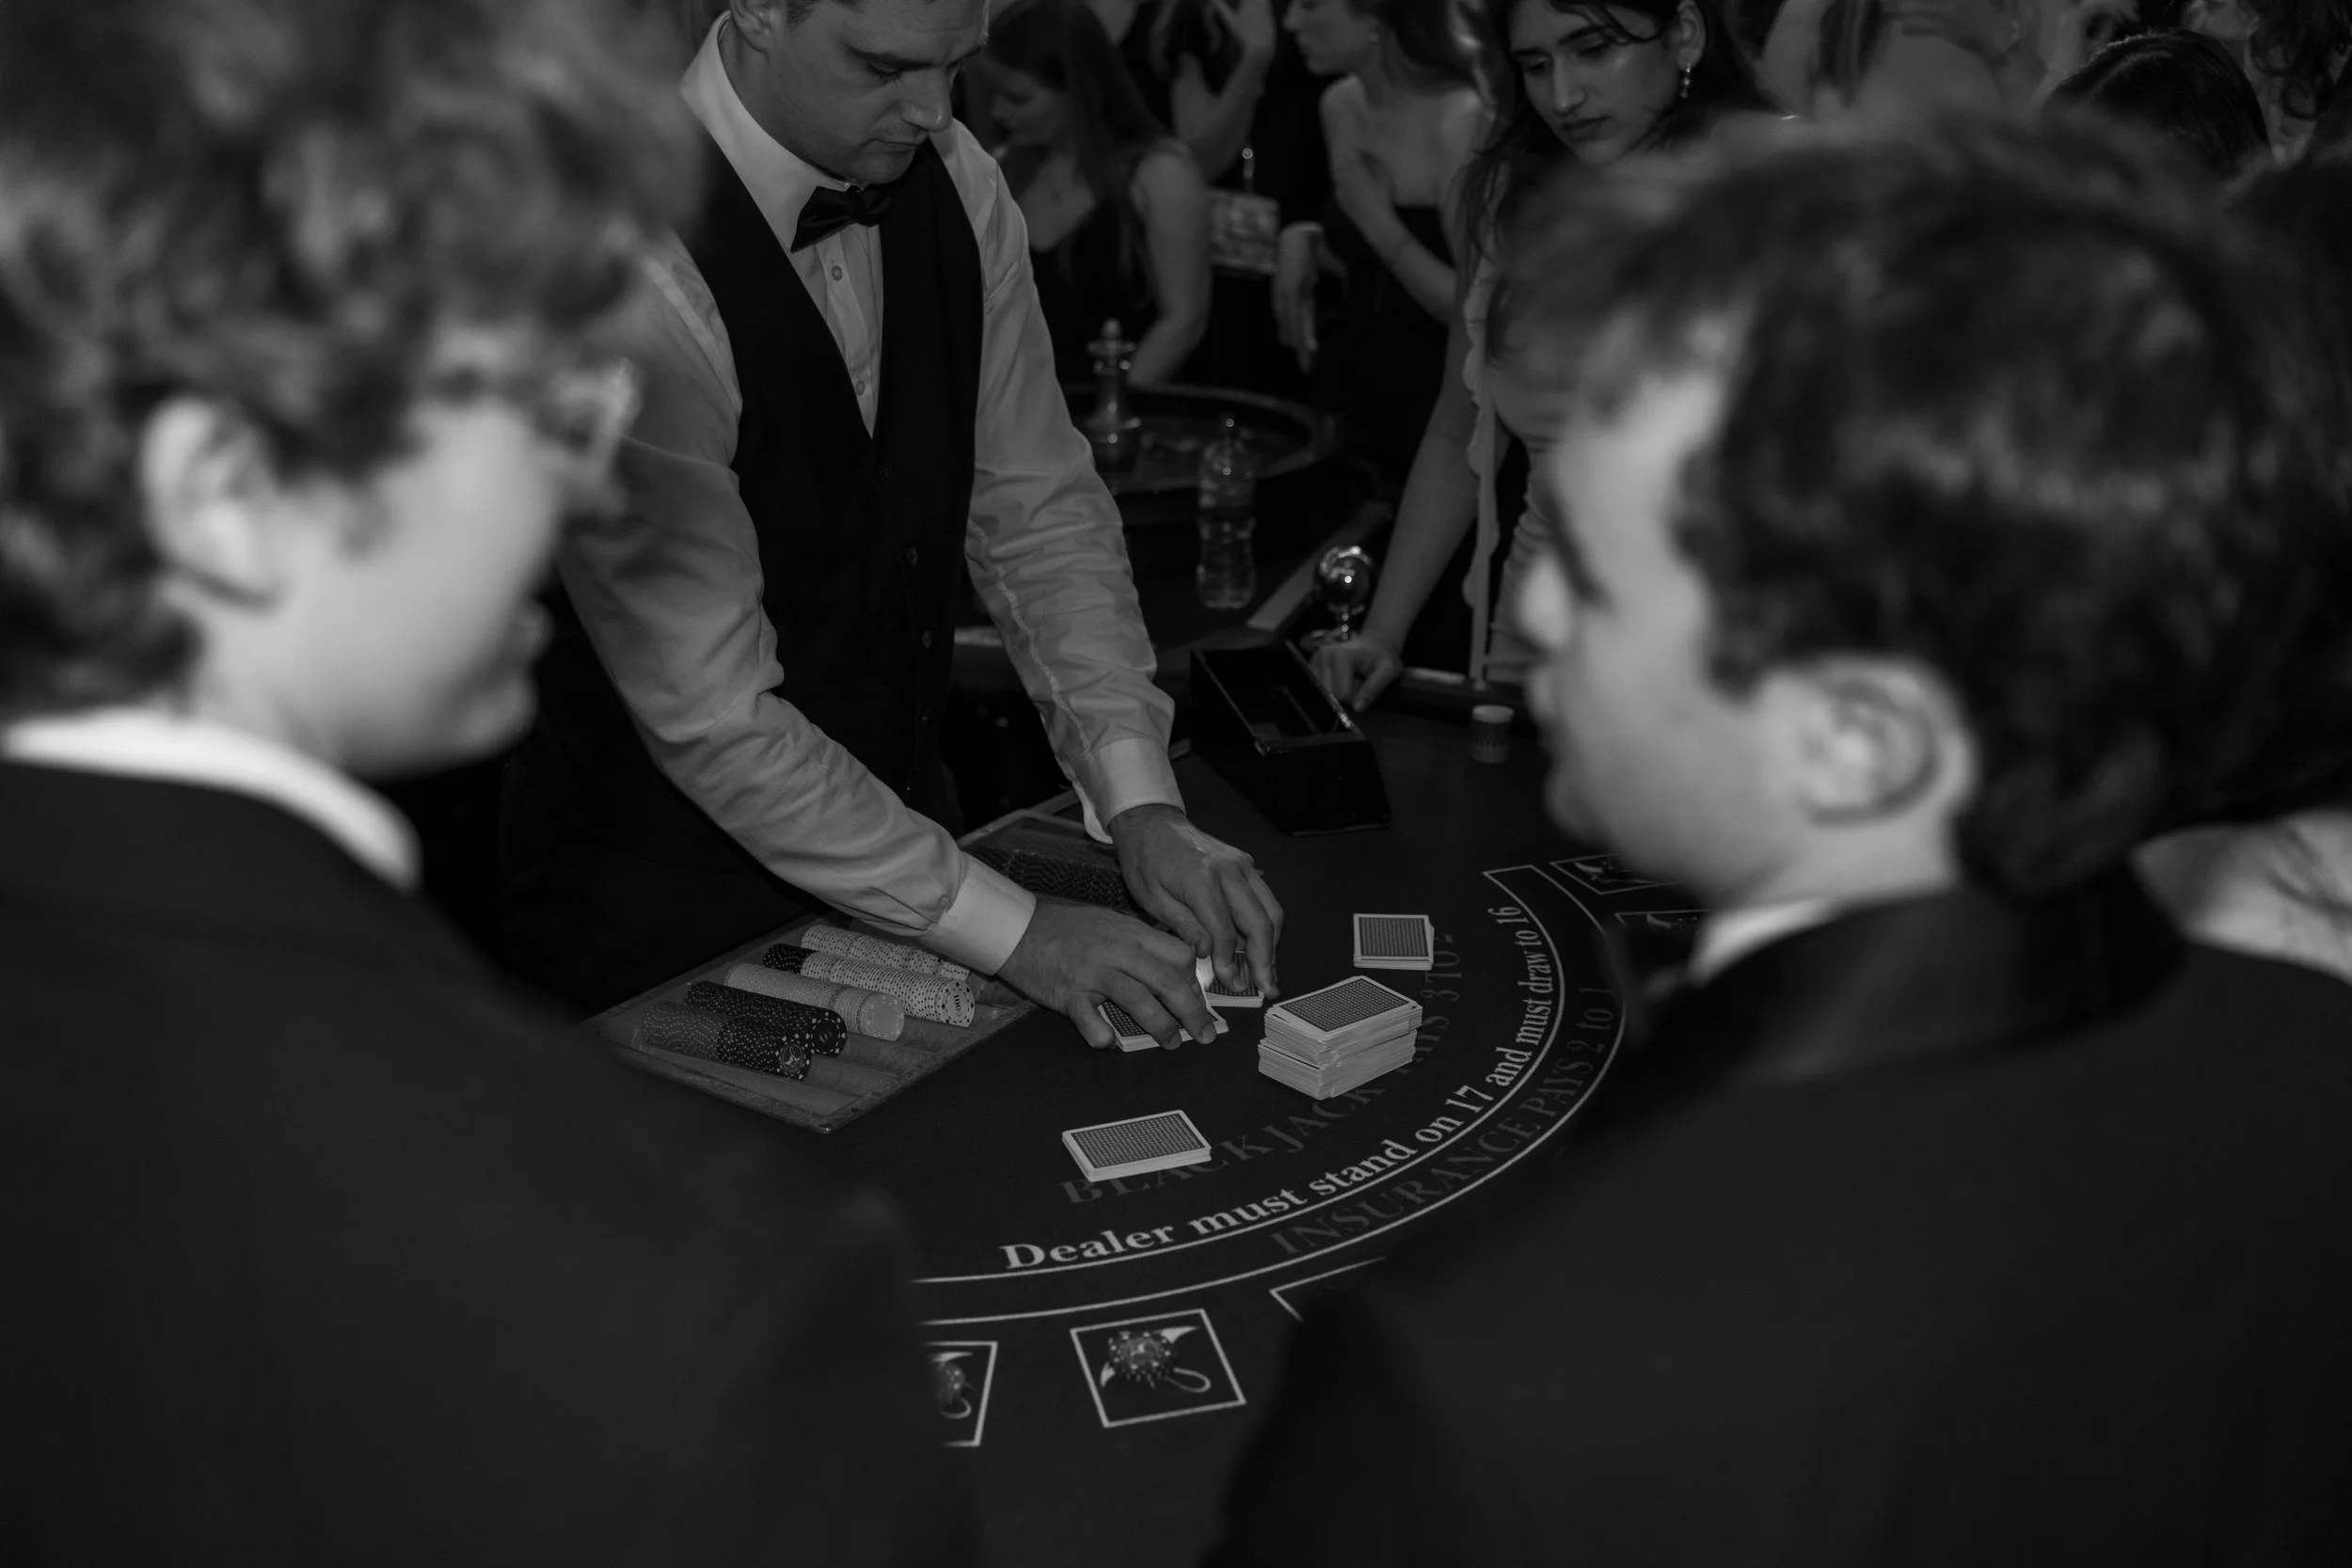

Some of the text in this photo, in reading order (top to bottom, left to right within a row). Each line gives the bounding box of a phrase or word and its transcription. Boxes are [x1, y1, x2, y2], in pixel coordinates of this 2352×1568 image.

[1566, 1040, 1606, 1053] 2
[1573, 1007, 1614, 1030] to
[998, 907, 1553, 1269] Dealer must stand on 17 and must draw to 16
[1261, 1088, 1387, 1152] JACK
[1420, 989, 1460, 1002] 3
[1519, 1058, 1594, 1117] PAYS
[1269, 1117, 1535, 1255] INSURANCE
